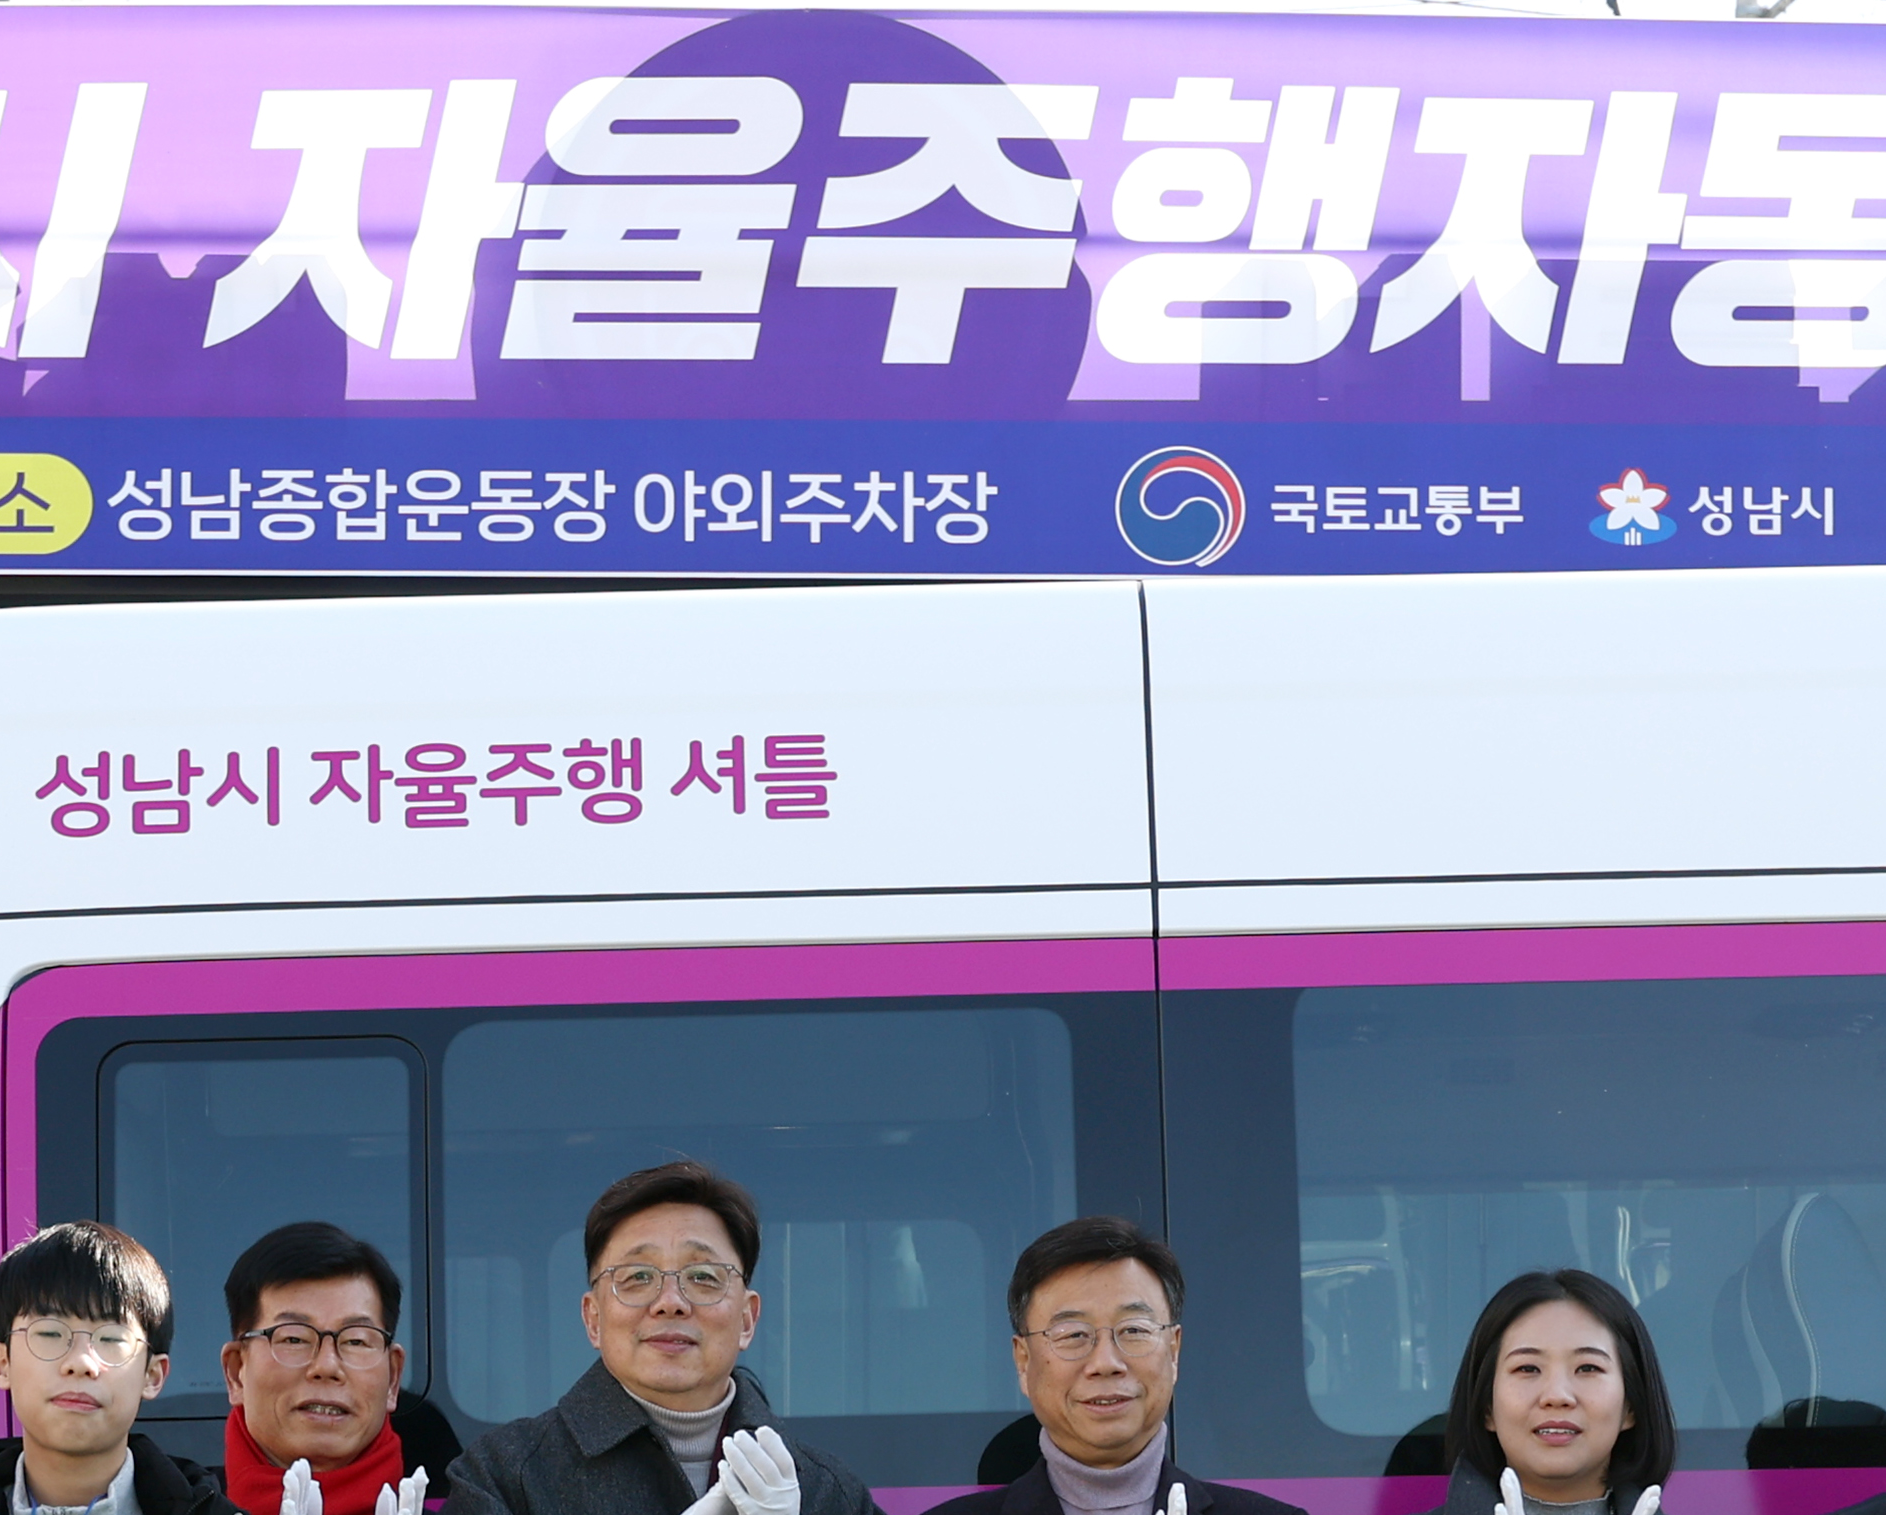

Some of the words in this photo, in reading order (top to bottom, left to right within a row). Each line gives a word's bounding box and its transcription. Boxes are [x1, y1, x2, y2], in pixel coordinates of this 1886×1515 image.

[108, 468, 615, 542] 성남종합운동장
[634, 471, 998, 543] 야외주차장
[1271, 485, 1524, 536] 국토교통부
[1689, 486, 1834, 536] 성남시
[36, 747, 280, 837] 성남시
[311, 738, 647, 828] 자율주행
[671, 735, 838, 820] 셔틀
